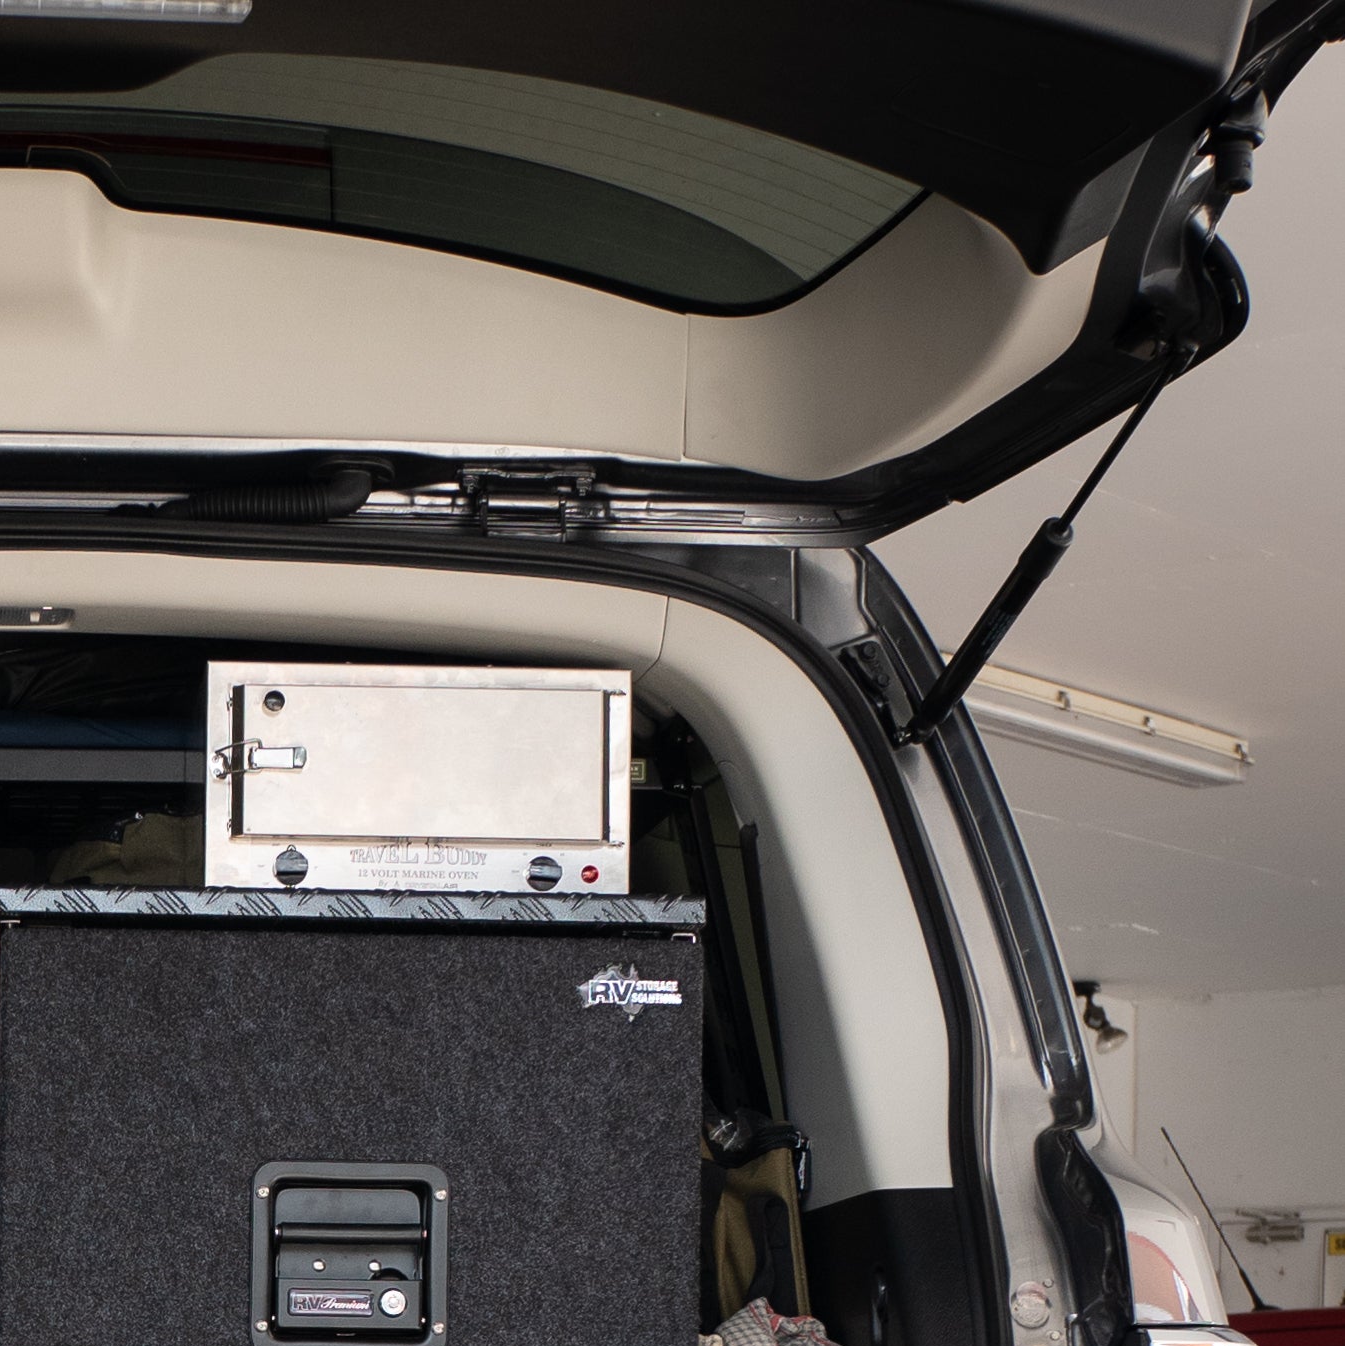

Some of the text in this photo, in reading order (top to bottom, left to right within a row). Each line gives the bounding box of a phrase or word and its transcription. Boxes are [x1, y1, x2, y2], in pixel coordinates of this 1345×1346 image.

[350, 843, 487, 866] TRAVEL BUDDY
[358, 869, 479, 880] 12 VOLT MARINE OVEN
[589, 980, 635, 1004] RV
[636, 981, 678, 992] STORAGE
[632, 993, 682, 1004] SOLUTIONS
[294, 1294, 371, 1311] RV Premium
